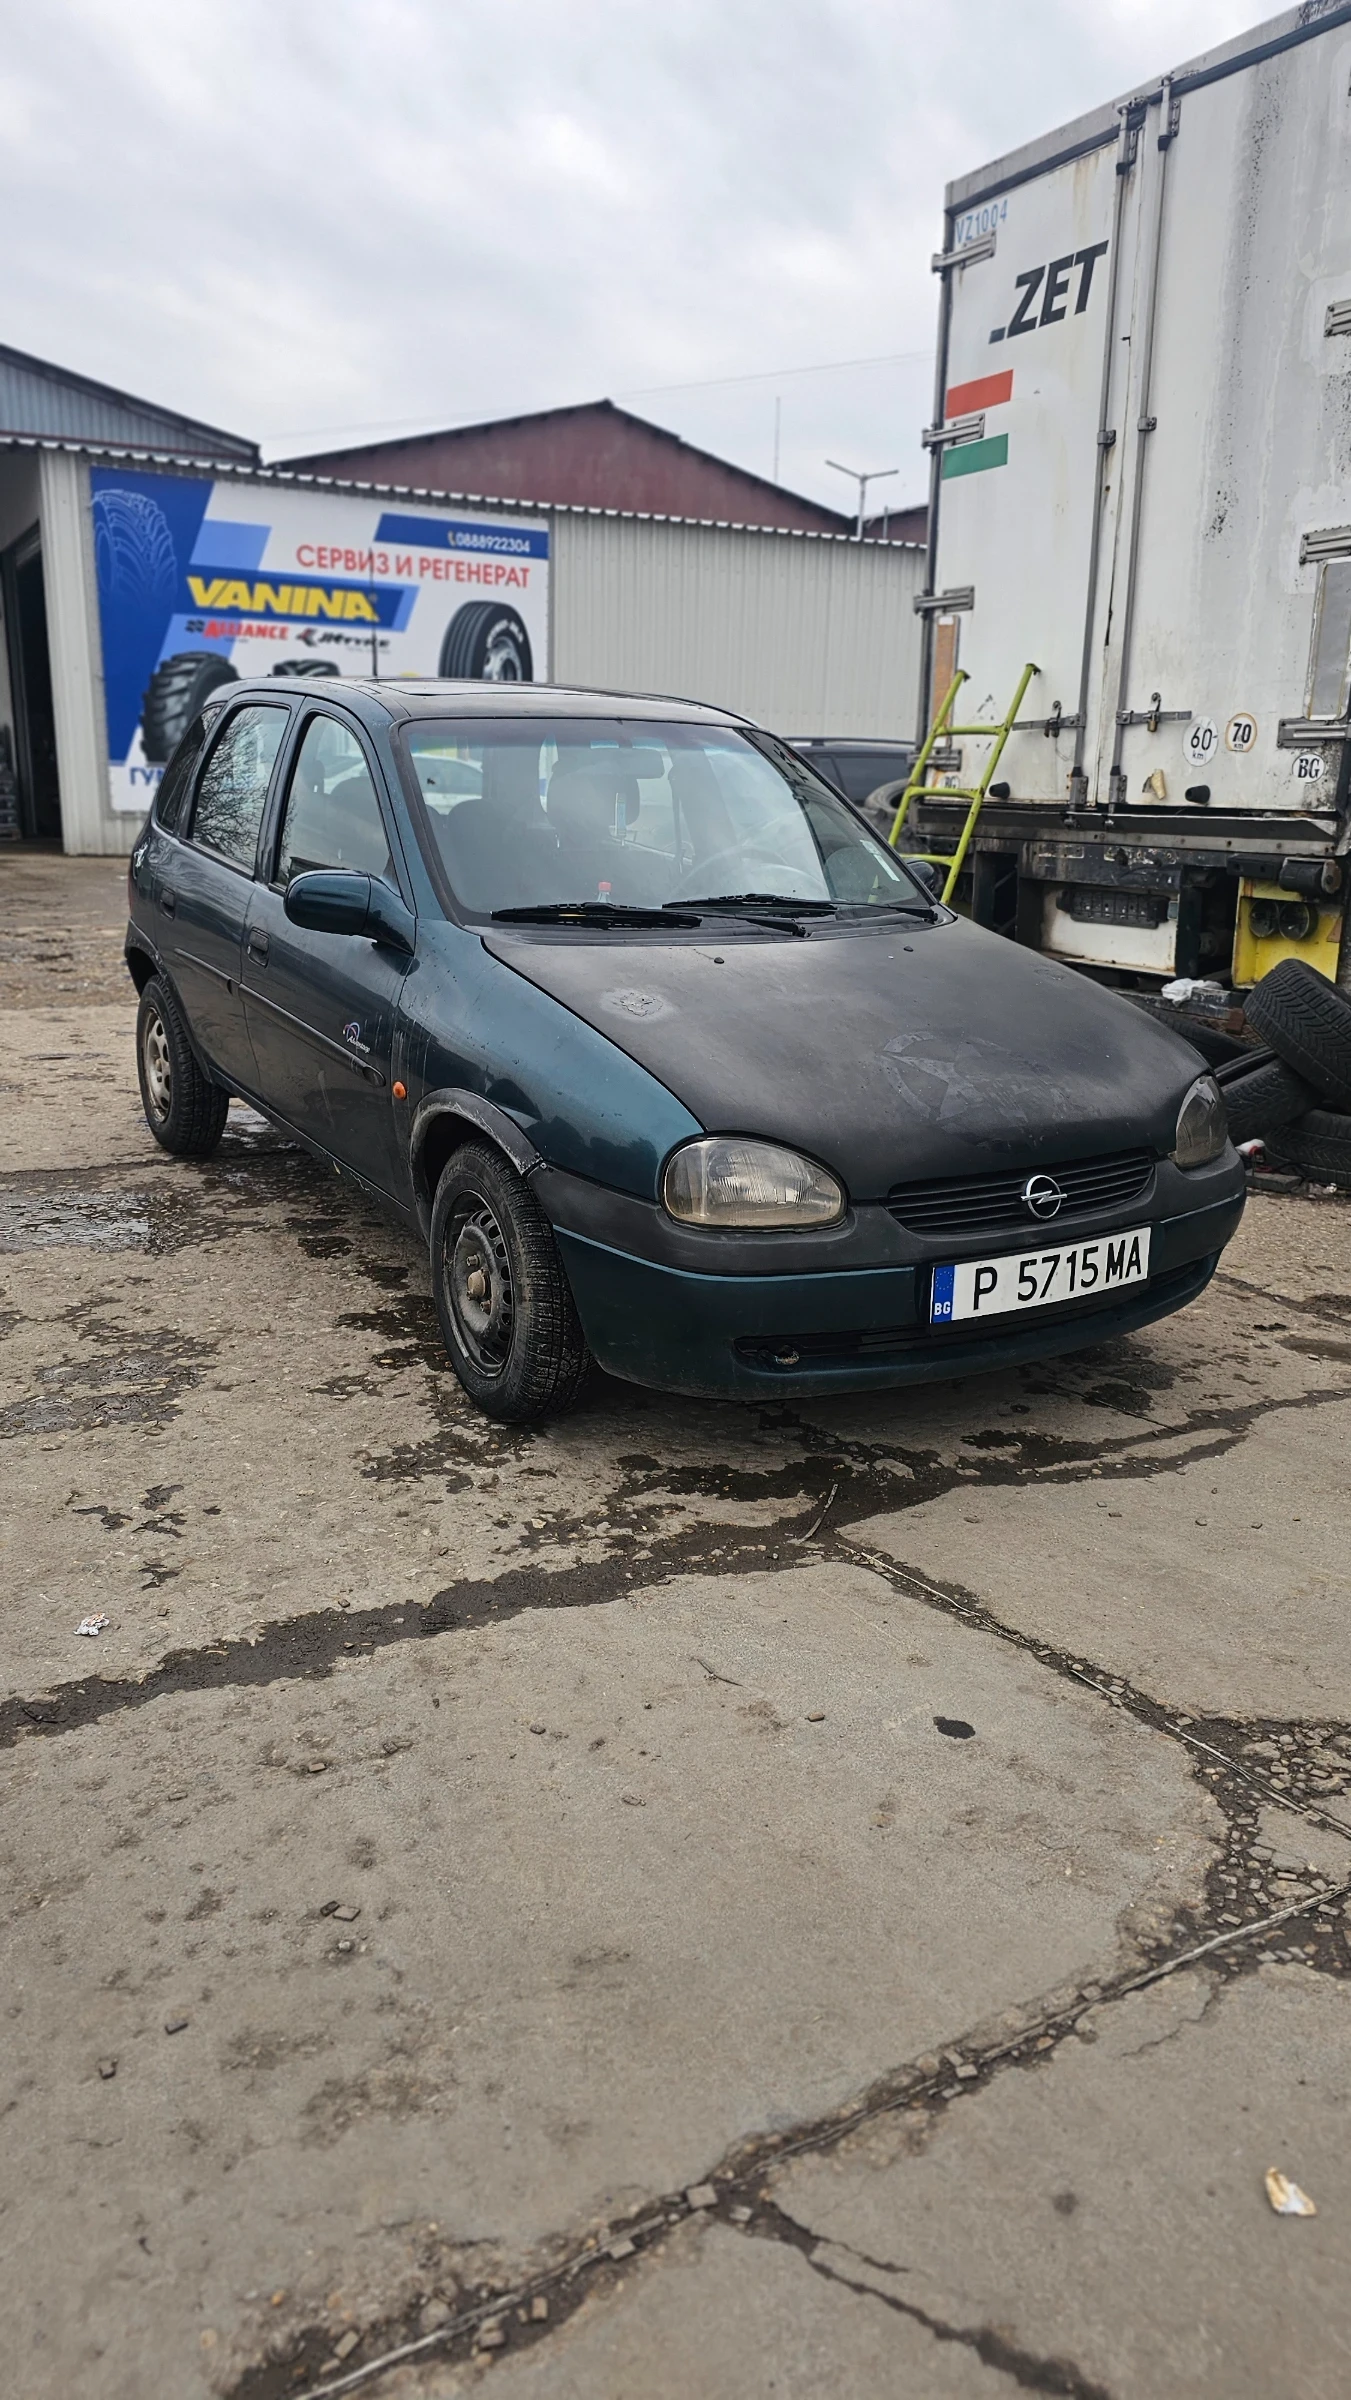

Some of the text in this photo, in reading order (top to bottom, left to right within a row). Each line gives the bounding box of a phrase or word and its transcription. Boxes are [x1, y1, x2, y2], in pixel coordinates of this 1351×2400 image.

[956, 199, 1008, 244] VZ1004
[456, 531, 531, 553] 0888922304
[296, 544, 530, 588] СЕРВИЗ И РЕГЕНЕРАТ
[186, 576, 380, 623] VANINA
[1190, 727, 1213, 750] 60
[1232, 722, 1253, 744] 70
[1192, 751, 1204, 760] km
[1297, 758, 1320, 779] BG
[973, 1266, 998, 1311] P
[934, 1301, 951, 1316] BG
